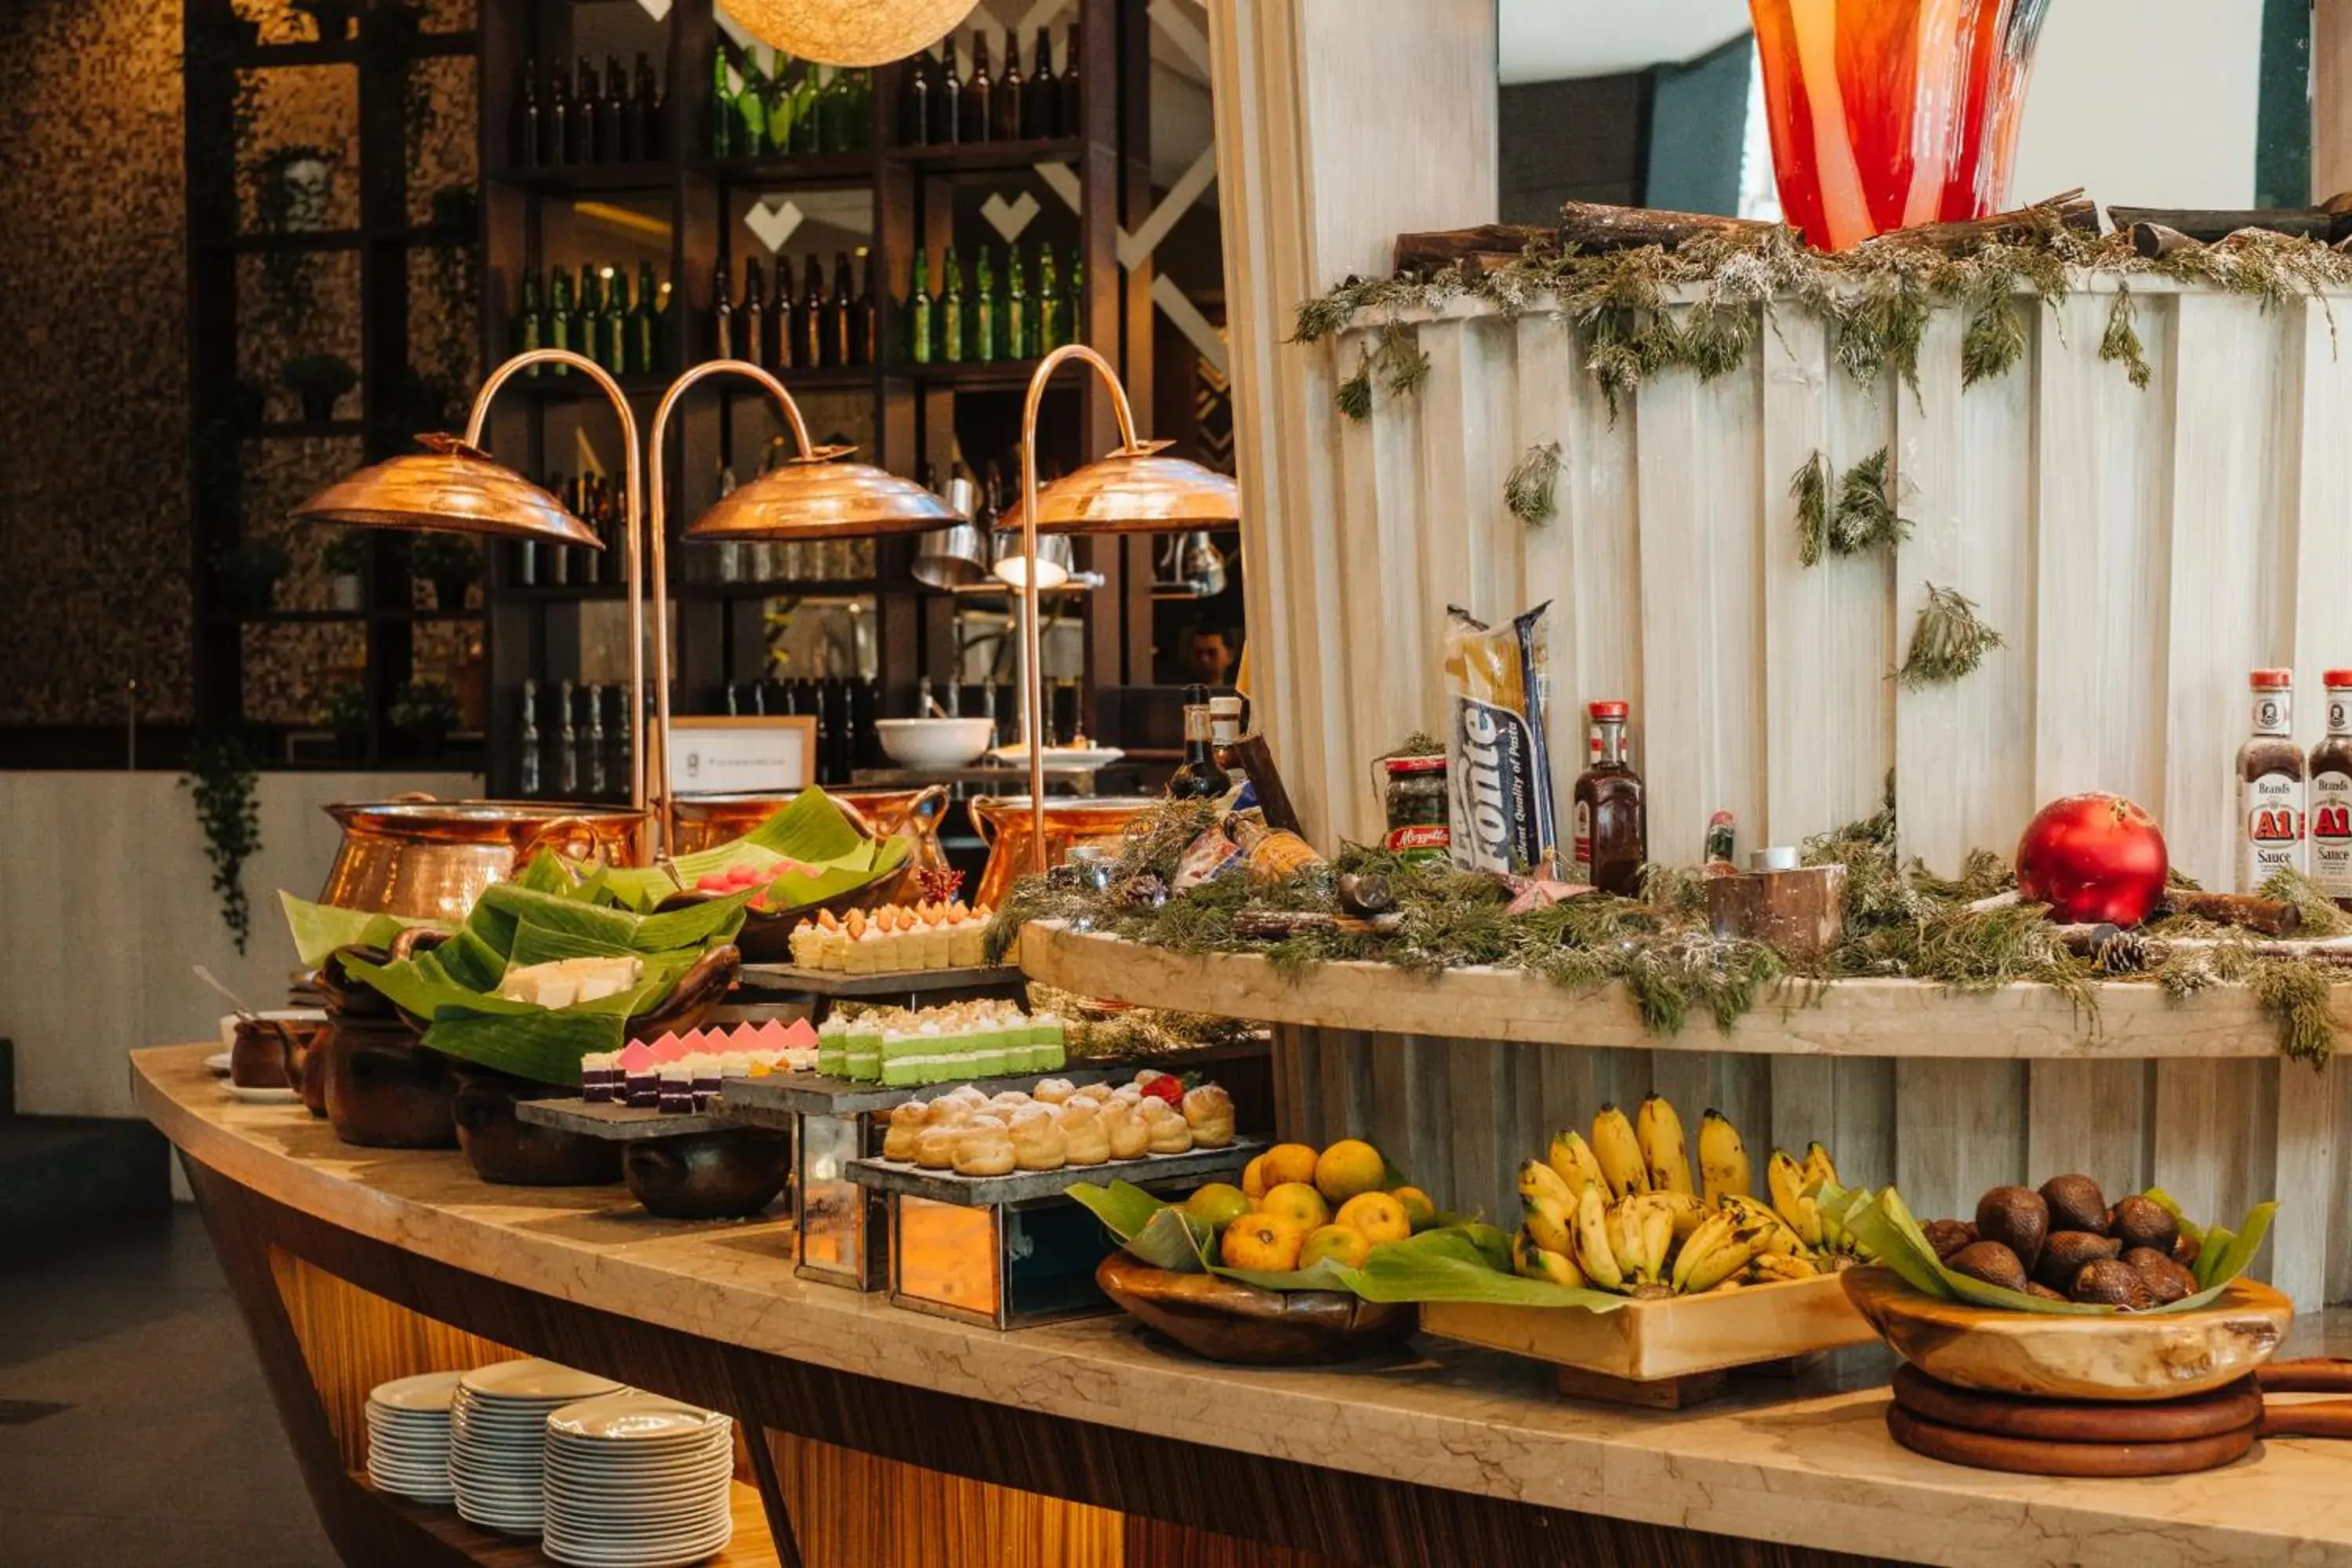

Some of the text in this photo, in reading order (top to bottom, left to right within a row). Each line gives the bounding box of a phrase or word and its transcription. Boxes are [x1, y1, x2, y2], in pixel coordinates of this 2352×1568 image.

[1507, 720, 1520, 757] Pasta
[1509, 757, 1522, 774] of
[1457, 707, 1509, 876] Fonte
[1511, 775, 1525, 822] Quality
[2254, 810, 2295, 840] A1
[2314, 808, 2352, 837] A1
[2257, 849, 2292, 863] Sauce
[2318, 847, 2350, 860] Sauce
